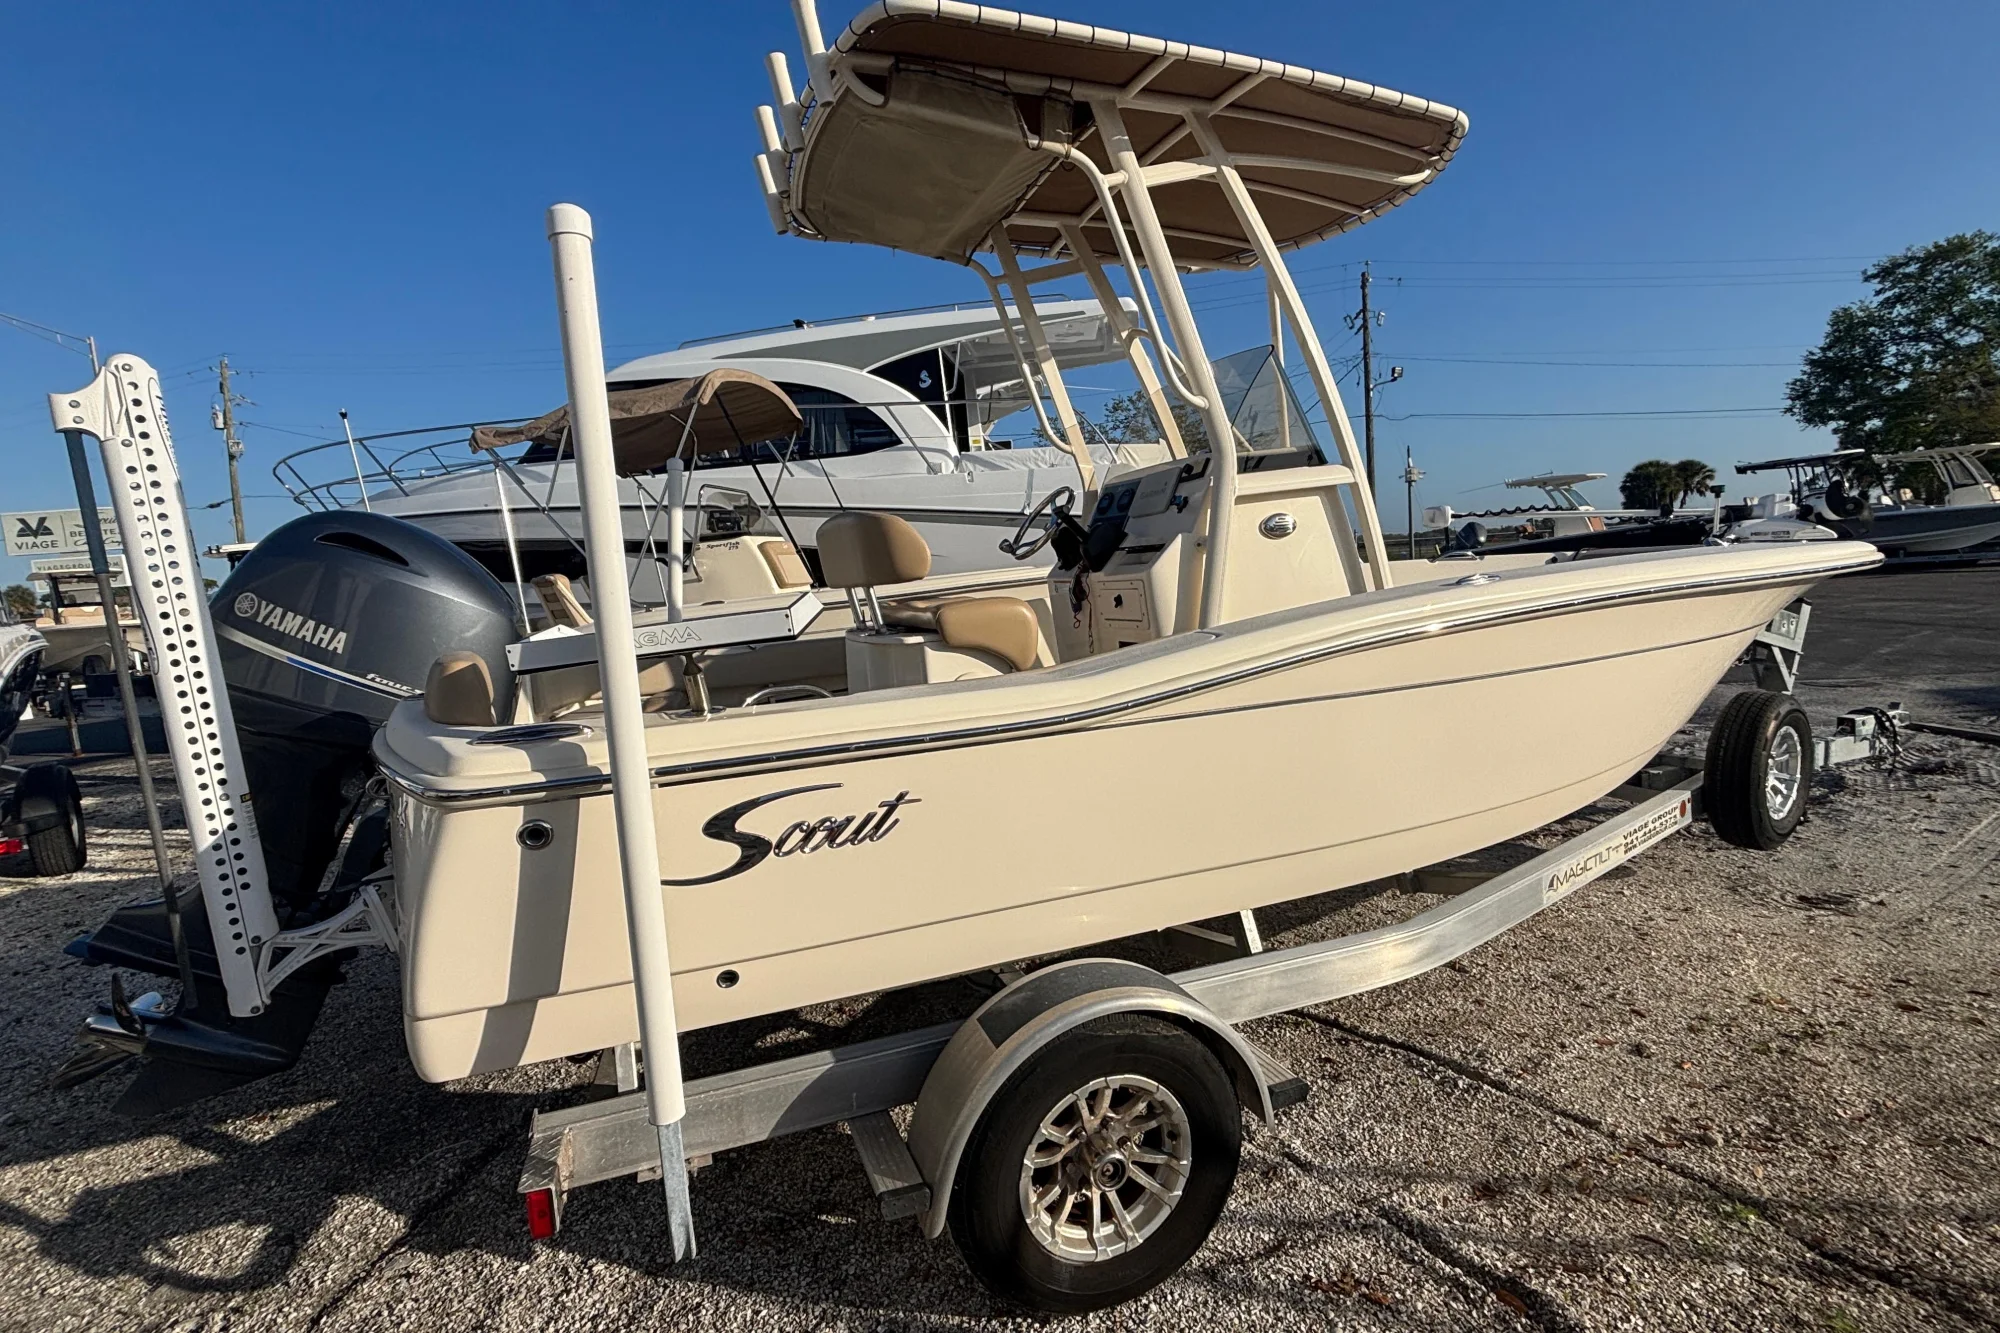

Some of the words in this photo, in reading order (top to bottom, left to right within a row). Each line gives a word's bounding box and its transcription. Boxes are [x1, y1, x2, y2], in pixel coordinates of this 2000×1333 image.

[15, 540, 59, 550] VIAGE
[256, 600, 347, 654] YAMAHA
[634, 626, 702, 648] GMA
[661, 783, 922, 886] Scout
[1623, 820, 1649, 840] VIAGE
[1651, 805, 1678, 824] GROUP
[1623, 814, 1678, 849] 941-444-5375
[1556, 846, 1612, 889] MAGICTILT
